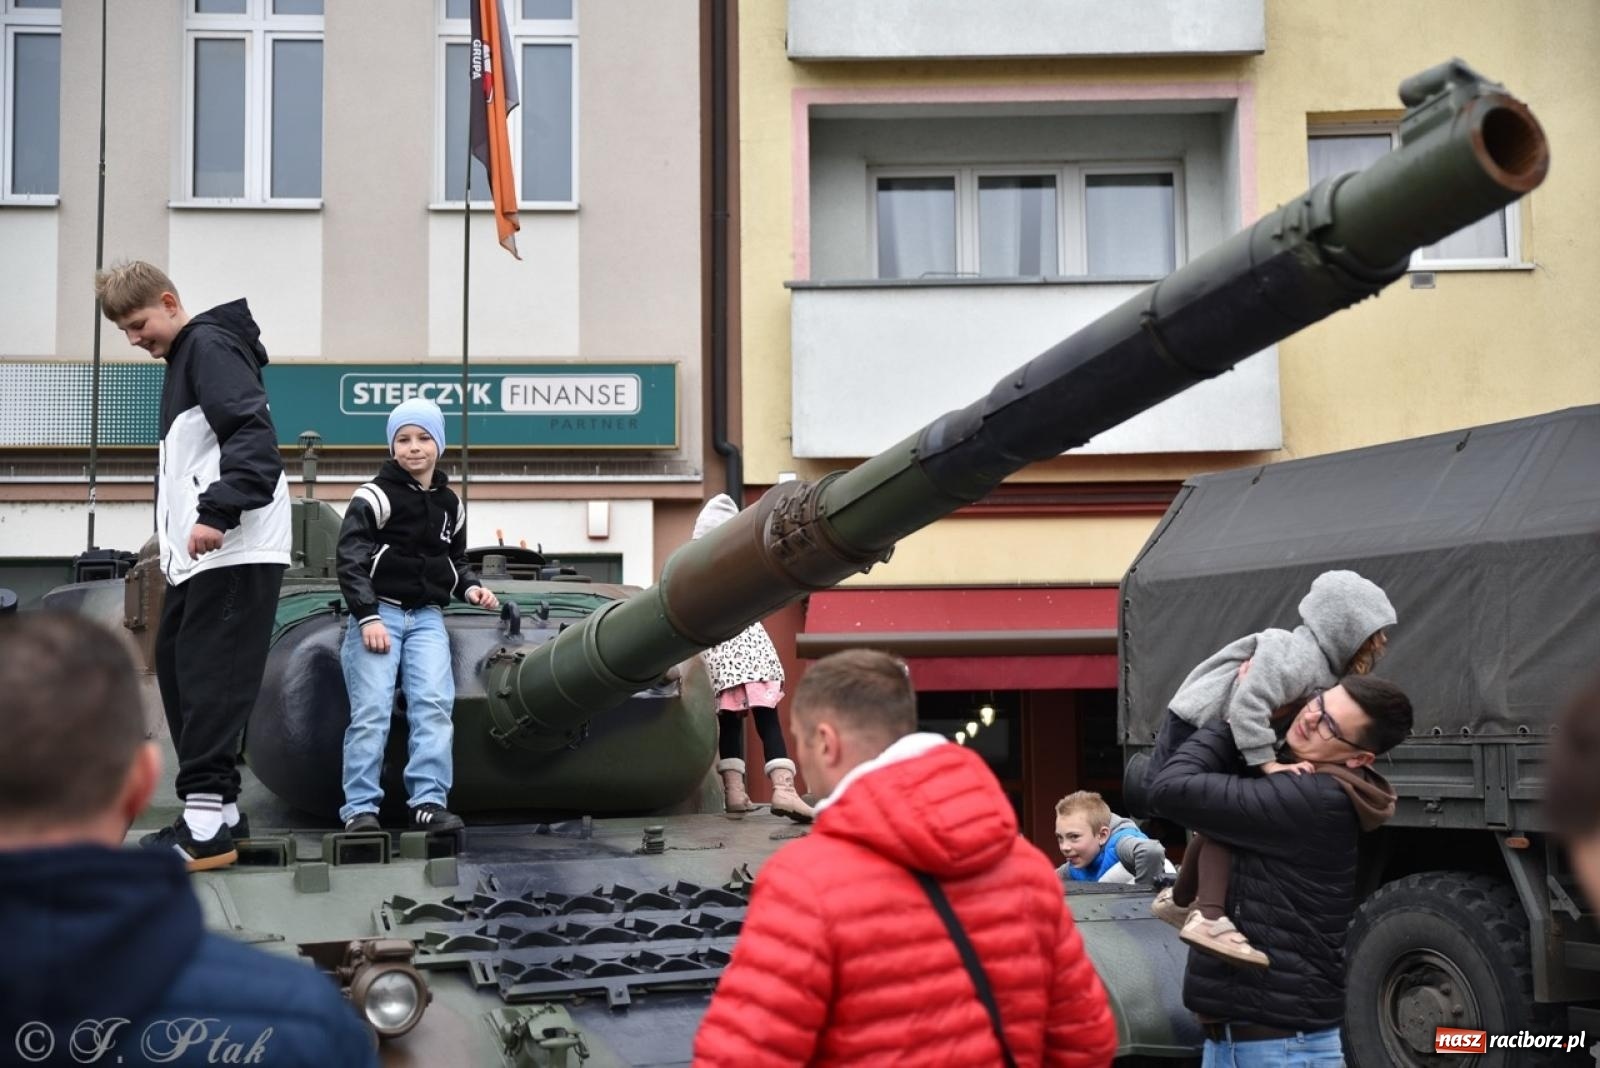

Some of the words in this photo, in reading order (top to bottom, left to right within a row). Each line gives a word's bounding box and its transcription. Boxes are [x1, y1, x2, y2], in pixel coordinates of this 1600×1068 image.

[471, 39, 482, 80] GRUPA
[353, 382, 492, 405] STEFCZYK
[510, 384, 626, 405] FINANSE
[550, 418, 639, 430] PARTNER
